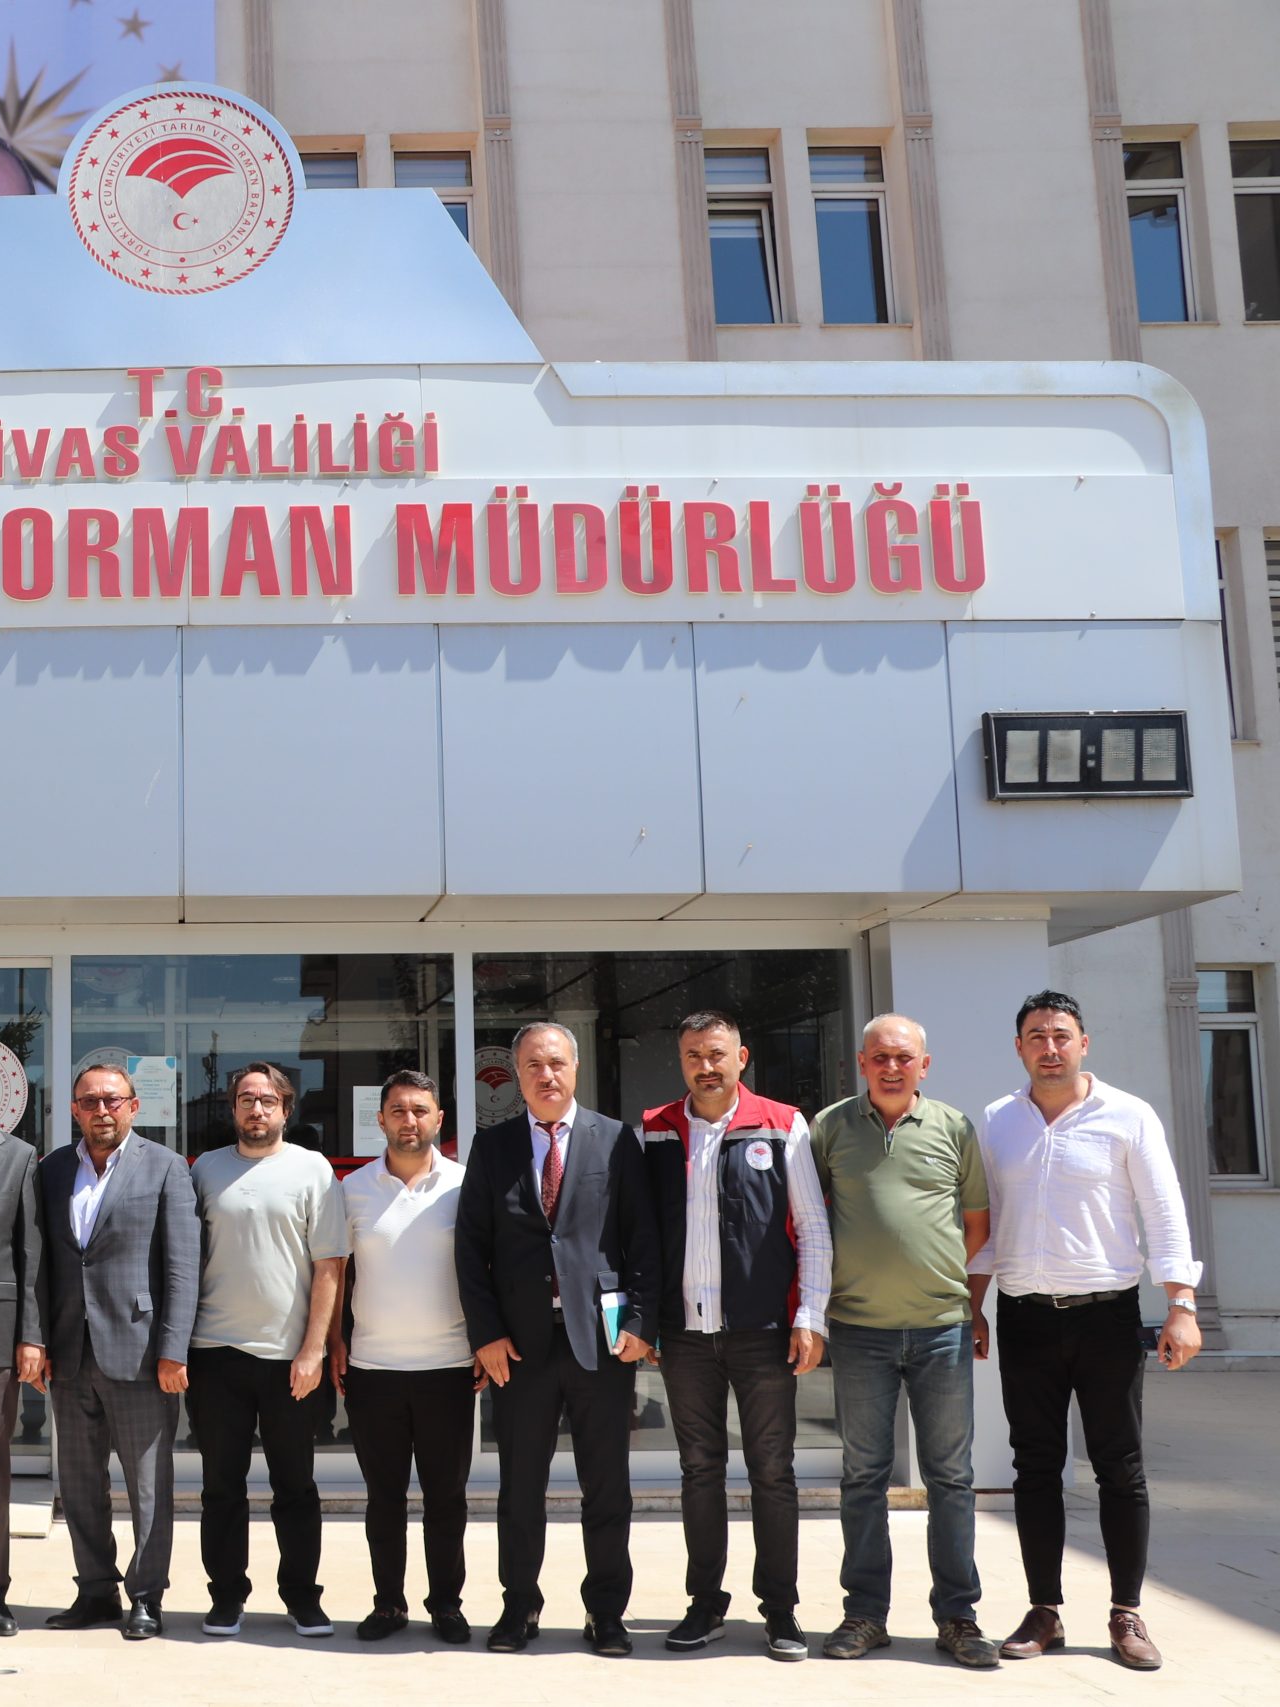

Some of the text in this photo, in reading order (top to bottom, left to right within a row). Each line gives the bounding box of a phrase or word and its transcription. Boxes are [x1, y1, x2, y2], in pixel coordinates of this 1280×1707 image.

[161, 122, 206, 133] TARIM
[213, 129, 229, 142] VE
[231, 143, 259, 186] ORMAN
[127, 366, 246, 418] T.C.
[165, 412, 440, 476] VALİLİĞİ
[1, 505, 353, 601] ORMAN
[395, 482, 986, 596] MÜDÜRLÜĞÜ
